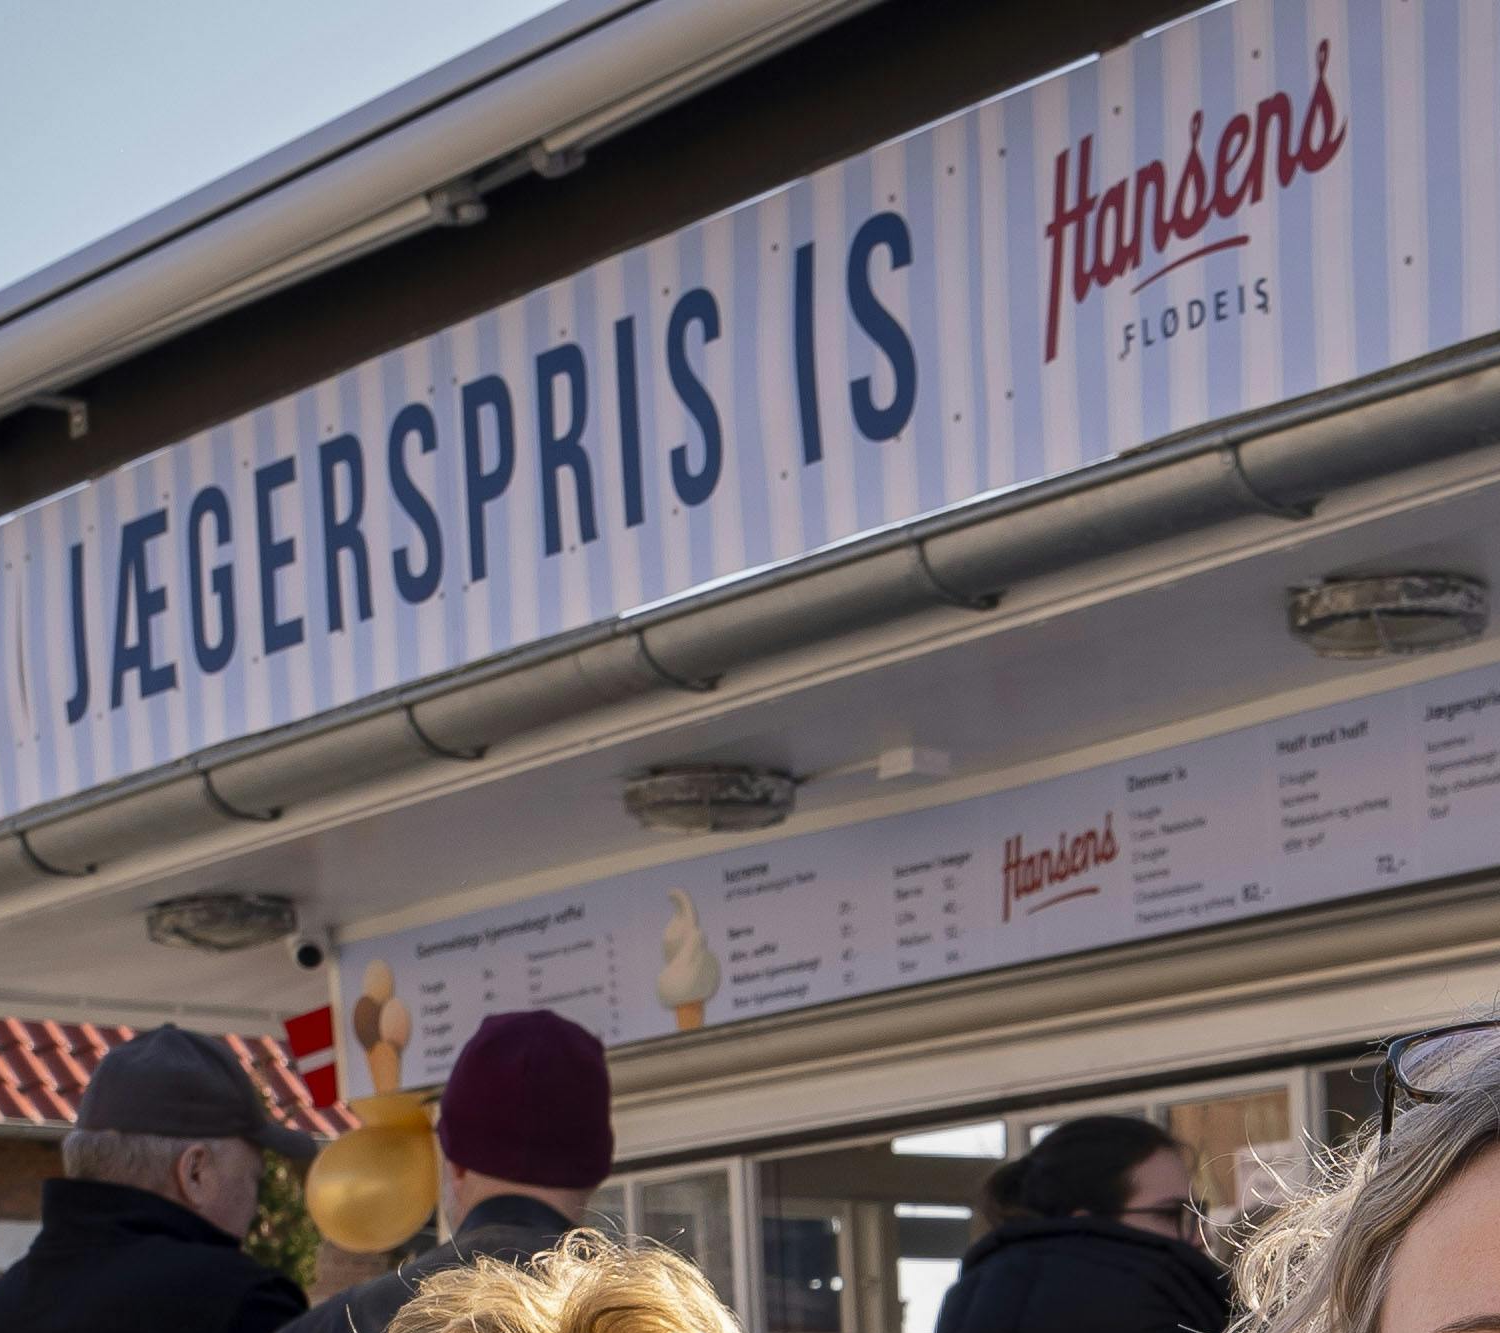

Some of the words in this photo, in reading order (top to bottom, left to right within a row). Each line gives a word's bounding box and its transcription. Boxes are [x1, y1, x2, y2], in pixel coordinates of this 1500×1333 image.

[1045, 39, 1348, 362] Hansens
[1121, 277, 1272, 360] FLØDEIS
[67, 286, 725, 725] JÆGERSPRIS
[794, 211, 918, 466] IS
[1003, 810, 1120, 925] Hansens
